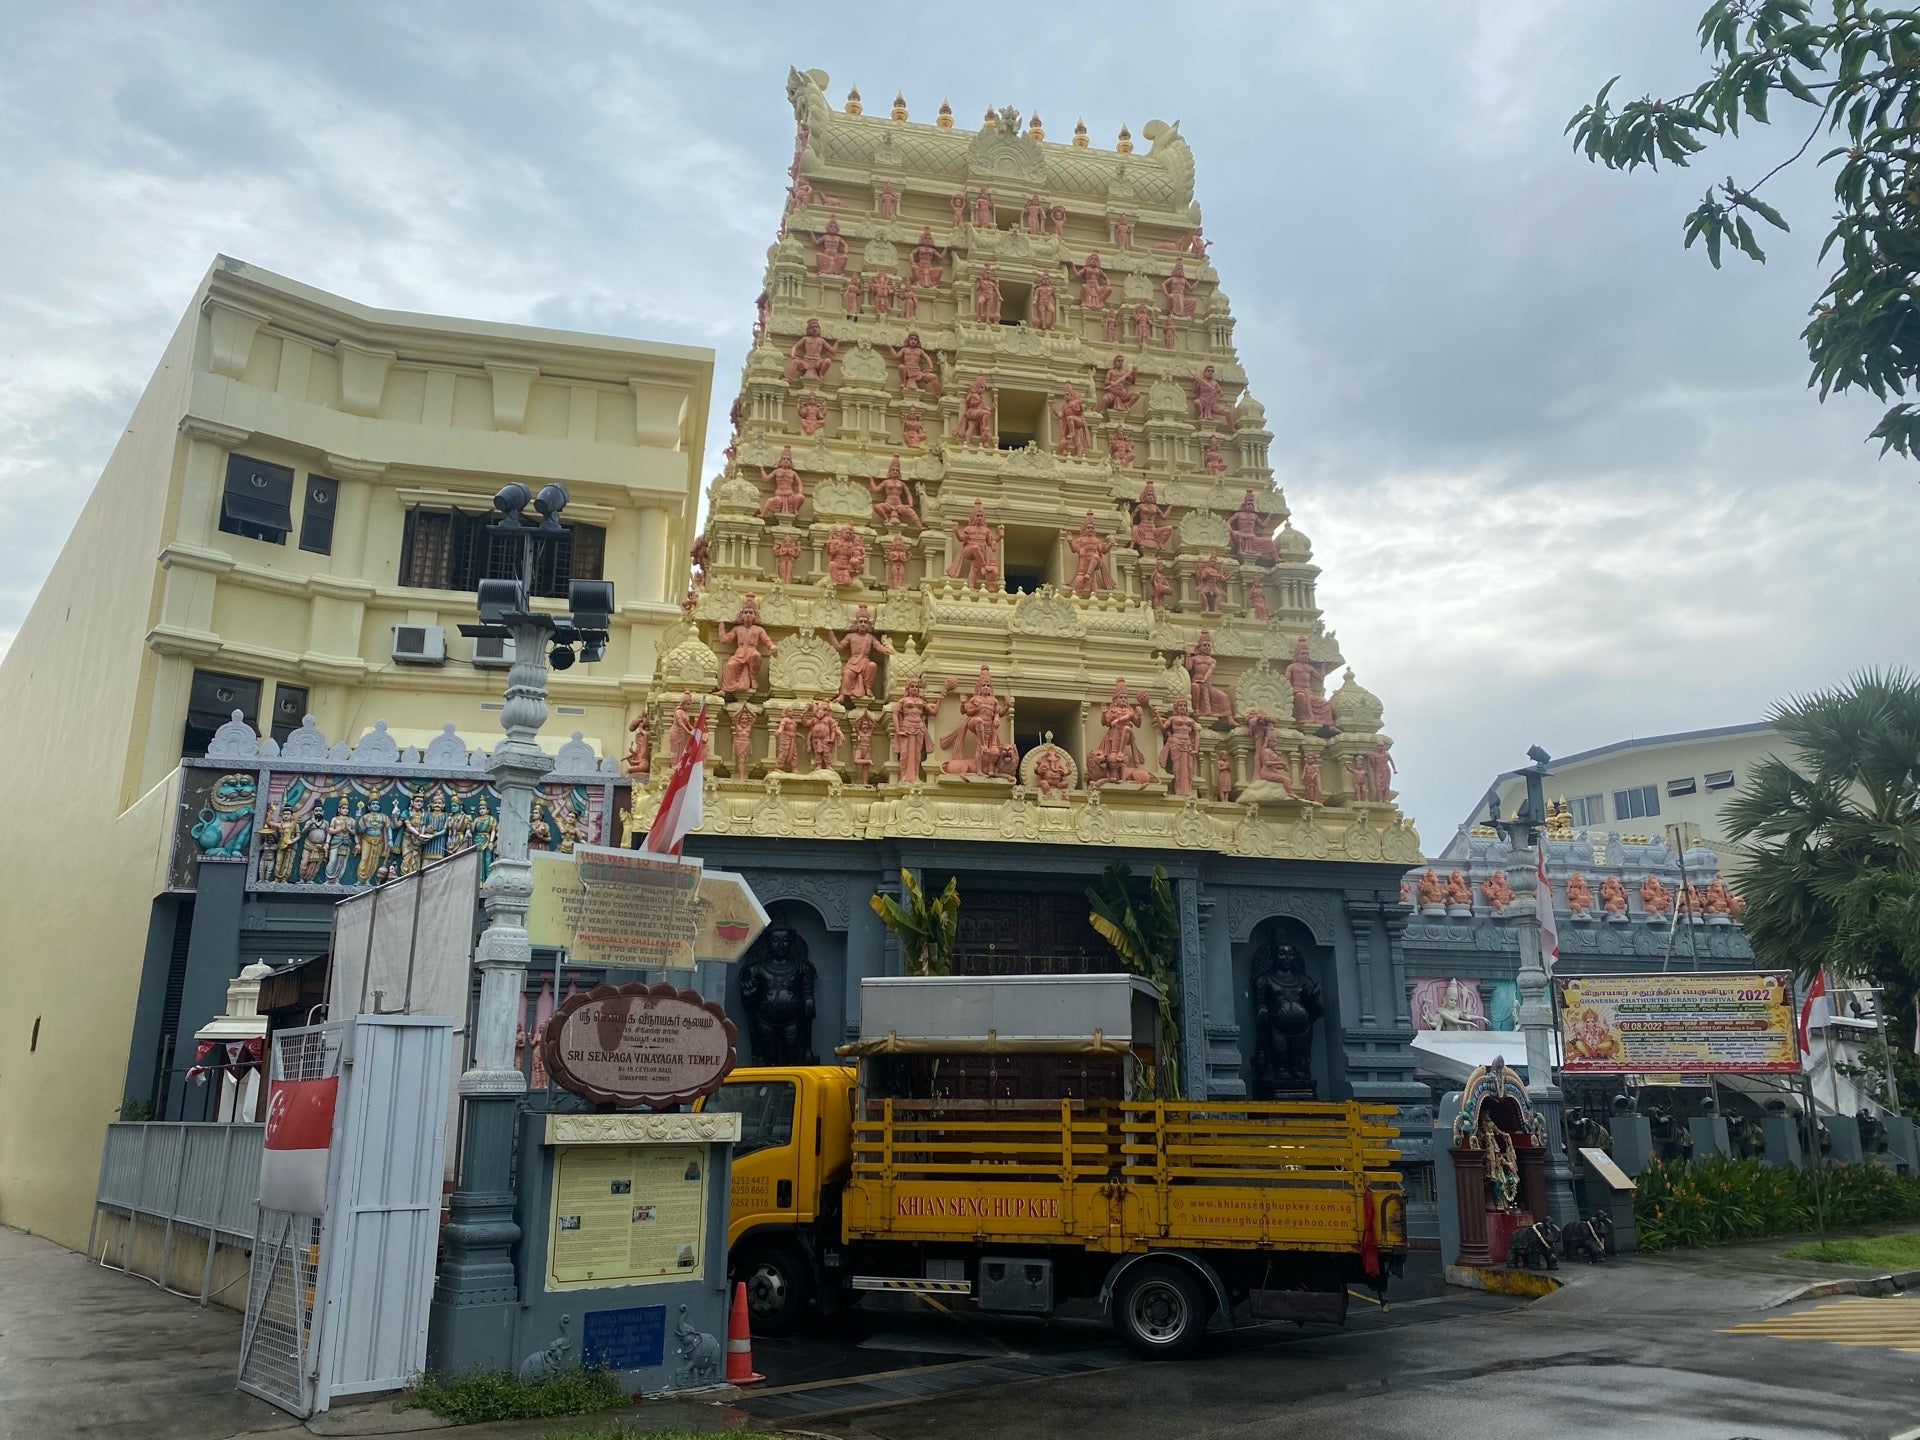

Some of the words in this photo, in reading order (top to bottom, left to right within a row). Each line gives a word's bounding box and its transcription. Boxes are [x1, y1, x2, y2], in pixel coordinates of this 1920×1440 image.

[608, 854, 631, 865] WAY
[551, 886, 568, 894] FOR
[617, 910, 649, 919] DEEMED
[588, 917, 612, 925] WASH
[614, 919, 635, 927] YOUR
[638, 920, 656, 929] FEET
[587, 925, 618, 934] TEMPLE
[630, 929, 668, 939] FRIENDLY
[579, 934, 629, 944] PHYSICALLY
[588, 943, 605, 951] MAY
[608, 944, 625, 952] YOU
[627, 945, 637, 953] BE
[614, 953, 636, 961] YOUR
[1736, 989, 1771, 1001] 2022
[567, 1050, 584, 1061] SRI
[588, 1051, 632, 1063] SENPAGA
[634, 1053, 684, 1065] VINAYAGAR
[688, 1054, 721, 1066] TEMPLE
[731, 1176, 749, 1185] 6253
[731, 1186, 750, 1194] 6250
[730, 1198, 749, 1207] 6252
[896, 1196, 946, 1217] KHIAN
[949, 1197, 990, 1218] SENG
[994, 1197, 1026, 1218] HUP
[1028, 1198, 1060, 1219] KEE
[1189, 1199, 1352, 1214] www.khiansenghupkee.com.sg
[1192, 1213, 1349, 1227] khiansenghupkee@yahoo.com
